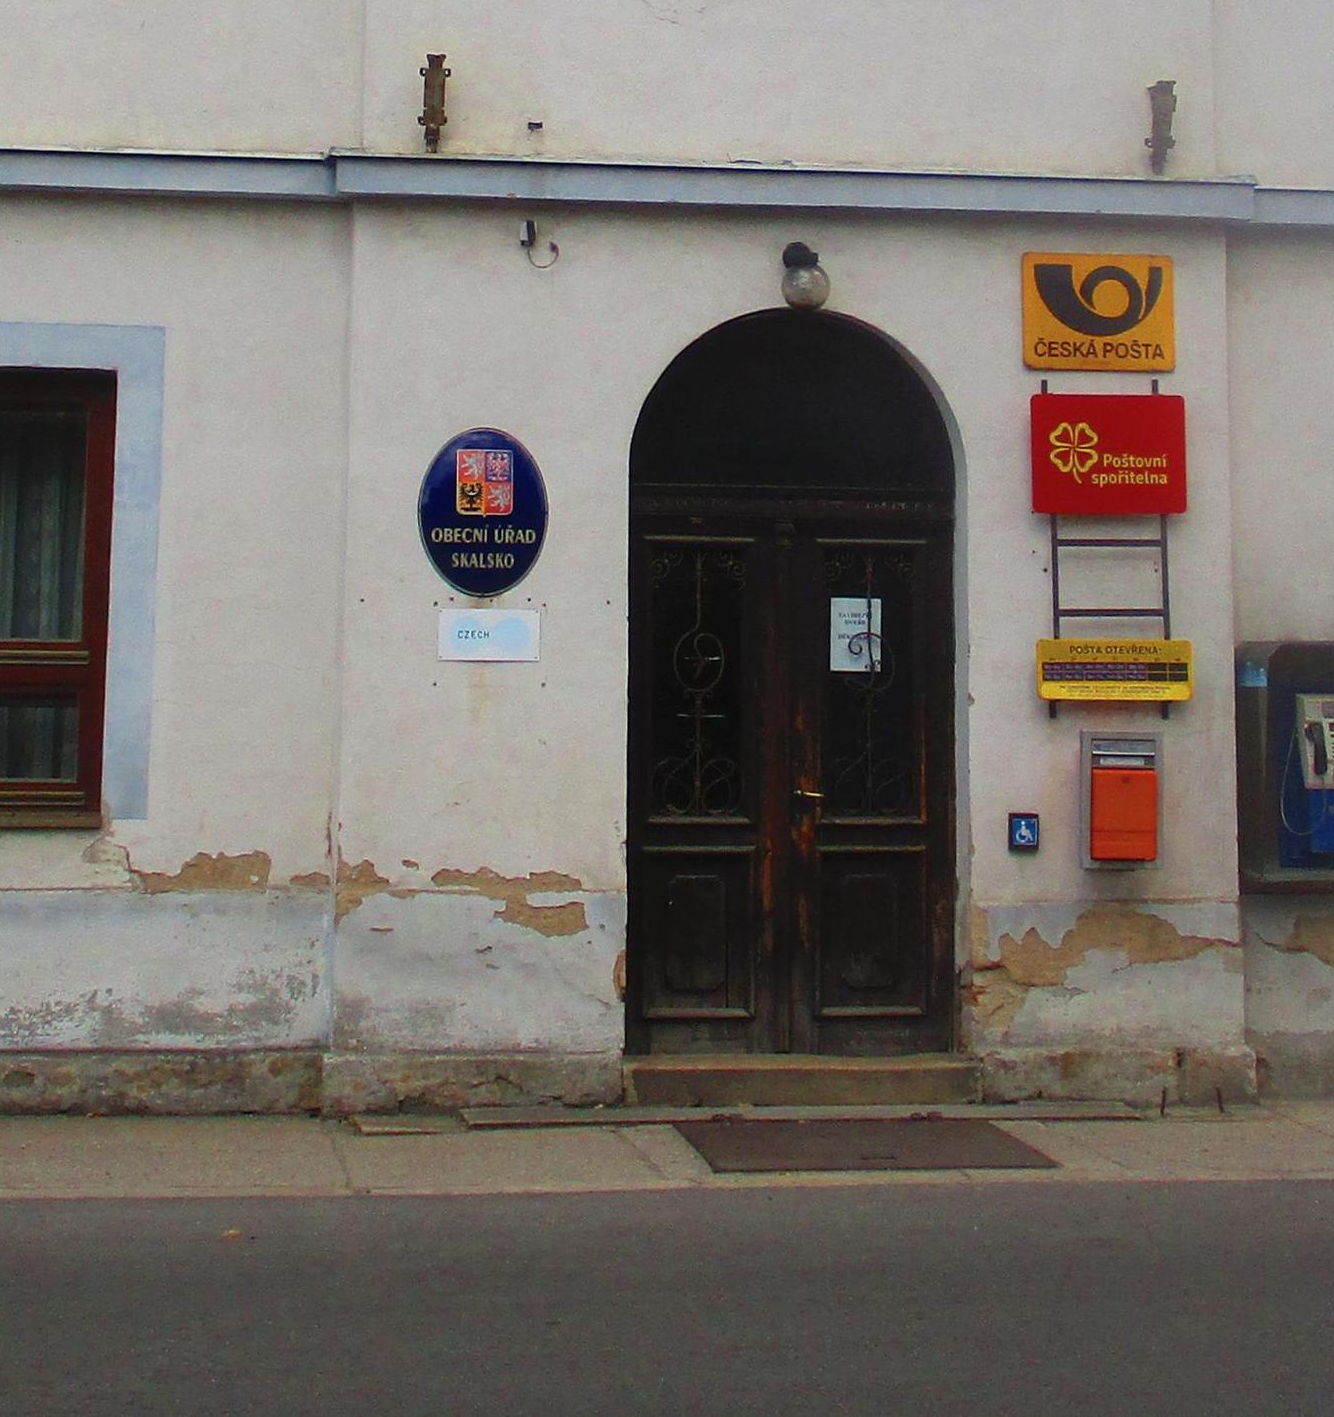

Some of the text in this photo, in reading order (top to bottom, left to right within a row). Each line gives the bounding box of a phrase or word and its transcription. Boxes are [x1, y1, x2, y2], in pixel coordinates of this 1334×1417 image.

[1034, 337, 1165, 360] ČESKÁ POŠTA
[1103, 453, 1167, 468] Poštovní
[1091, 470, 1168, 487] spořitelna
[431, 523, 536, 544] OBECNÍ ÚŘAD
[451, 552, 515, 569] SKALSKO
[457, 629, 490, 640] CZECH
[1069, 644, 1102, 655] POŠTA
